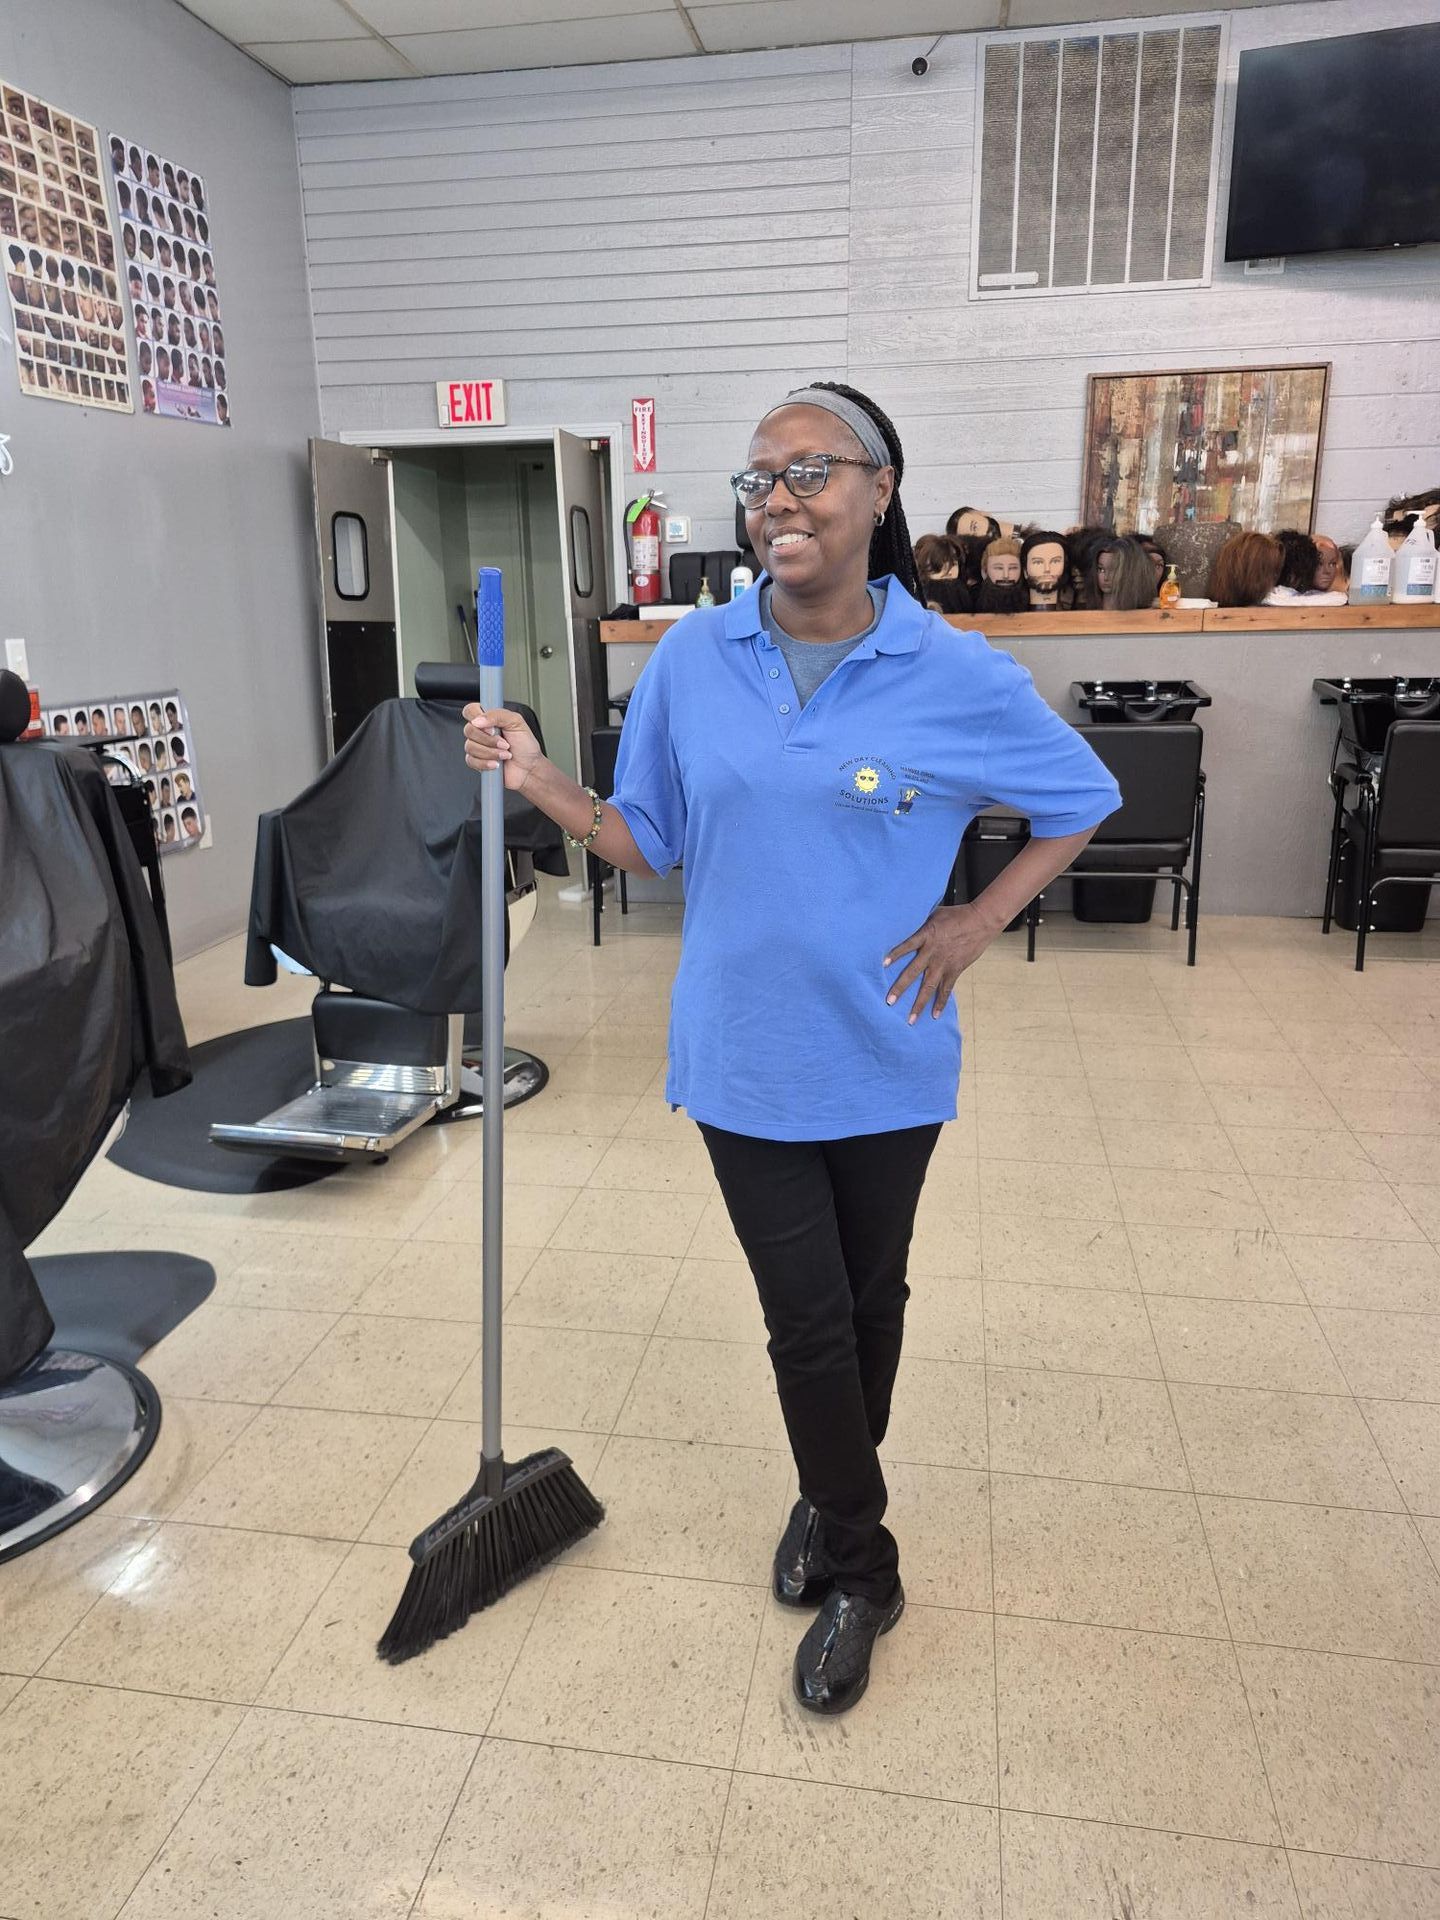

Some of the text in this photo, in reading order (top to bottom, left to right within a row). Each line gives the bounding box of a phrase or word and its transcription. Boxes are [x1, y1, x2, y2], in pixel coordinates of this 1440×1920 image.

[449, 383, 492, 422] EXIT
[839, 759, 853, 772] NEW
[870, 757, 897, 780] CLEANING
[839, 789, 889, 805] SOLUTIONS
